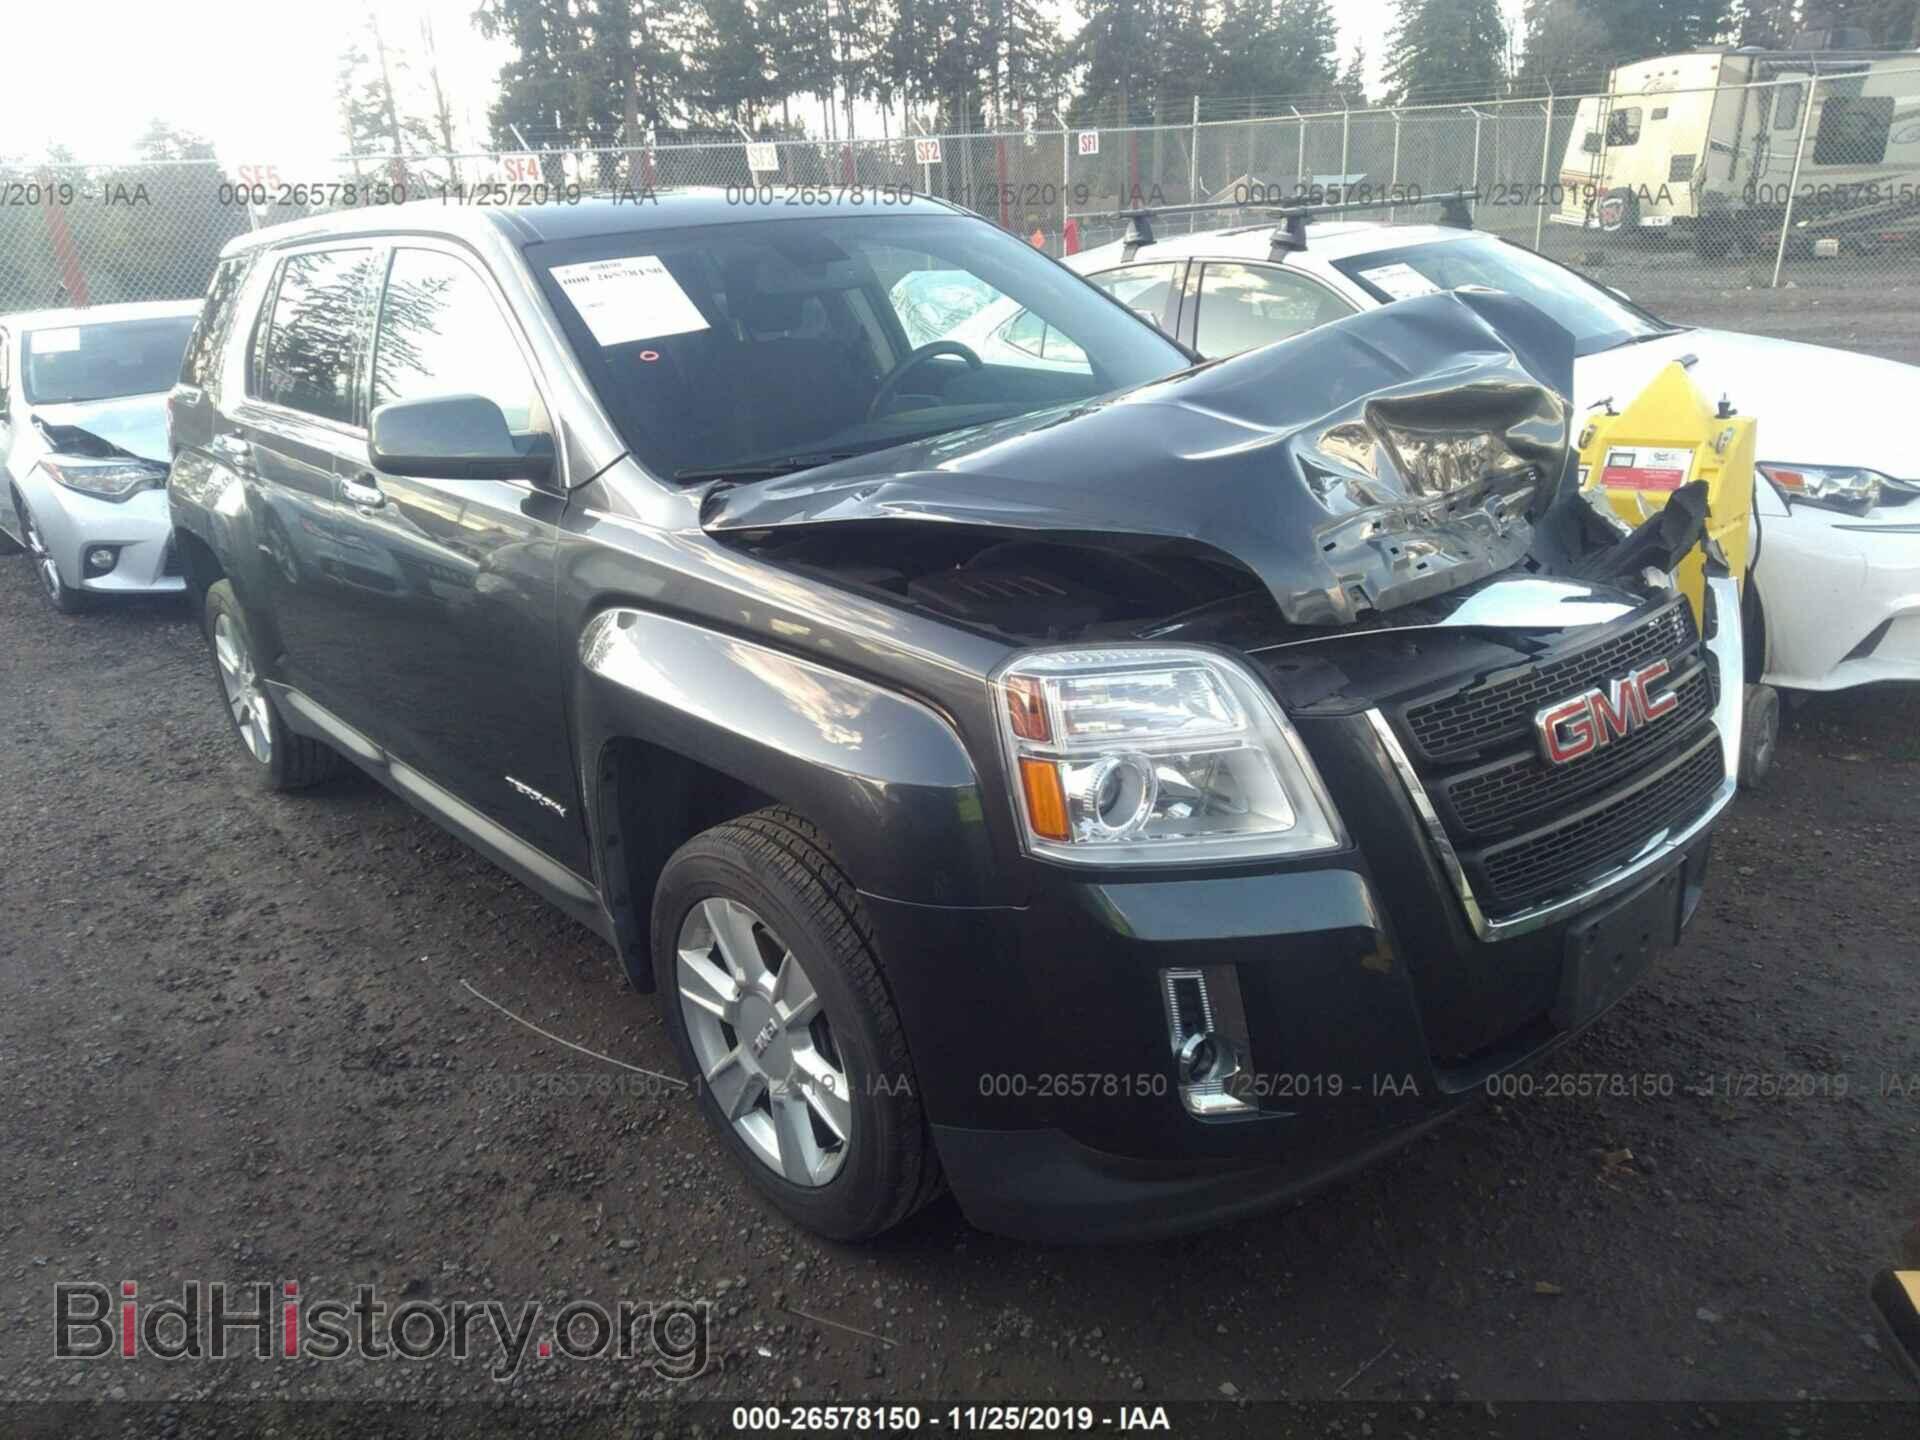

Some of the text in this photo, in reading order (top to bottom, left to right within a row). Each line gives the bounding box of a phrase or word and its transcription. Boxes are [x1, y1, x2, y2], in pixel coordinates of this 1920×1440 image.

[917, 141, 940, 160] SF2
[503, 155, 539, 182] SF4
[1536, 658, 1679, 764] GMC
